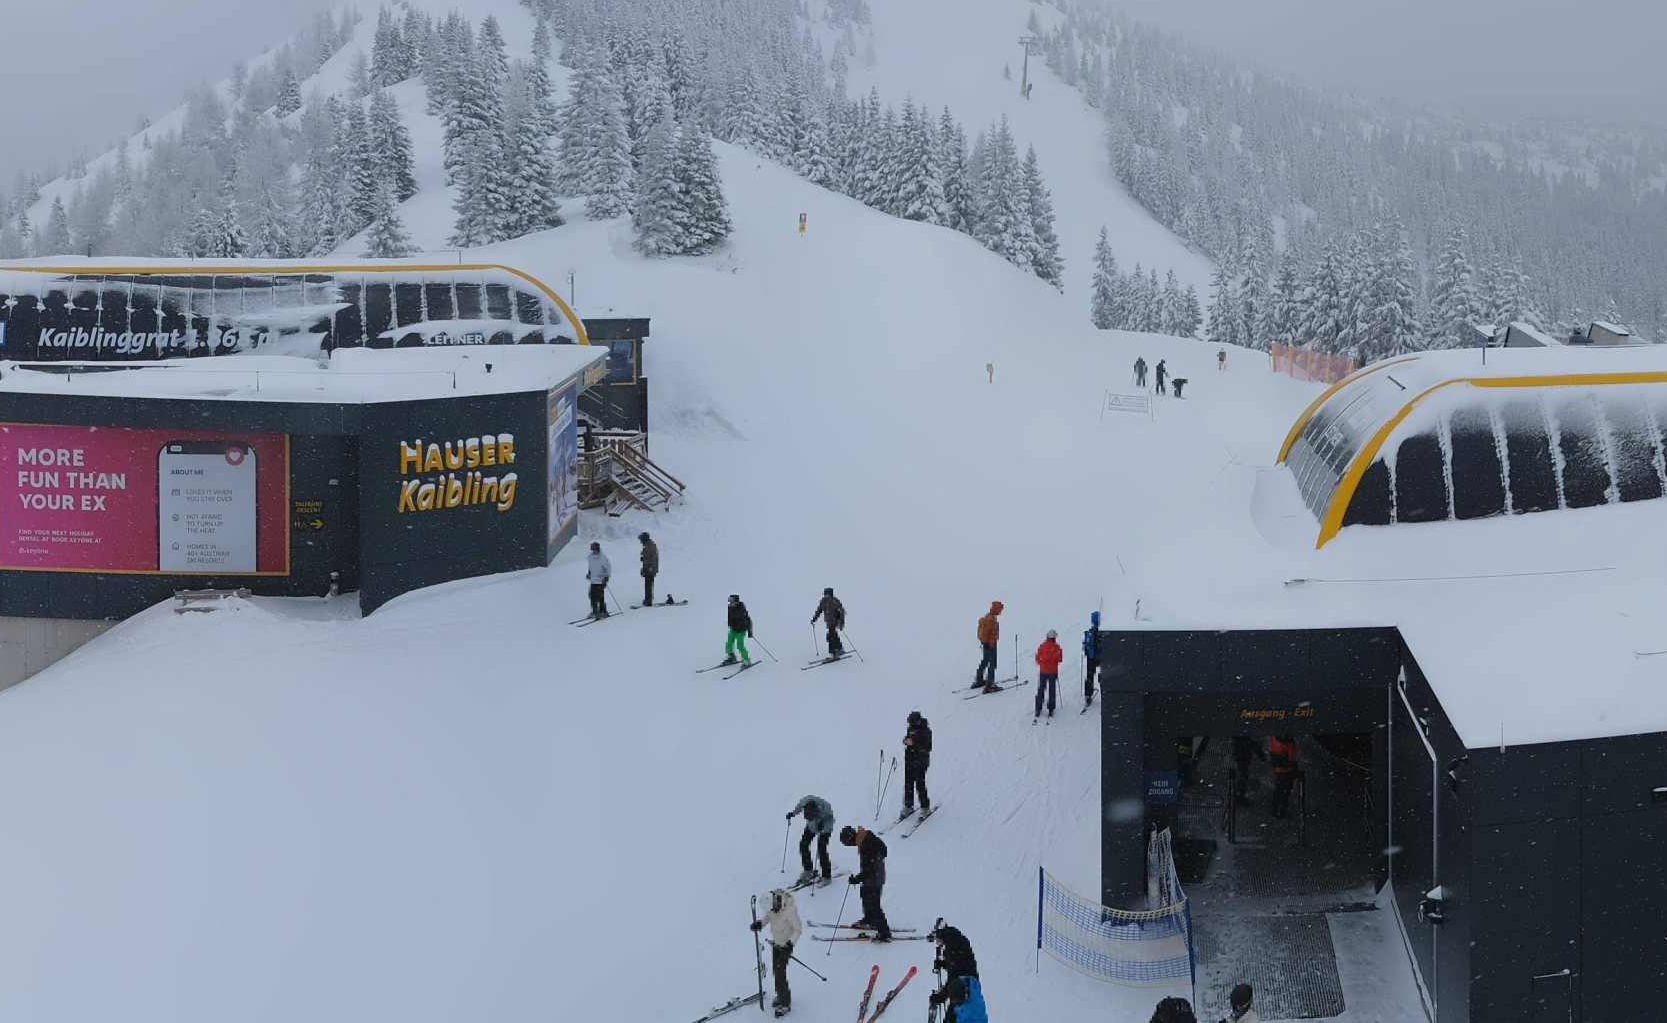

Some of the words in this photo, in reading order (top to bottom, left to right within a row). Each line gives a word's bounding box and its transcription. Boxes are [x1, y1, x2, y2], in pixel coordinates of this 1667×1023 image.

[38, 327, 180, 354] Kaiblinggrat
[18, 448, 84, 466] MORE
[400, 434, 515, 474] HAUSER
[18, 471, 59, 488] FUN
[66, 472, 126, 489] THAN
[398, 472, 517, 513] Kaibling
[19, 493, 74, 510] YOUR
[81, 495, 106, 511] EX
[1241, 709, 1286, 720] Ausgang
[1294, 707, 1315, 717] Exit
